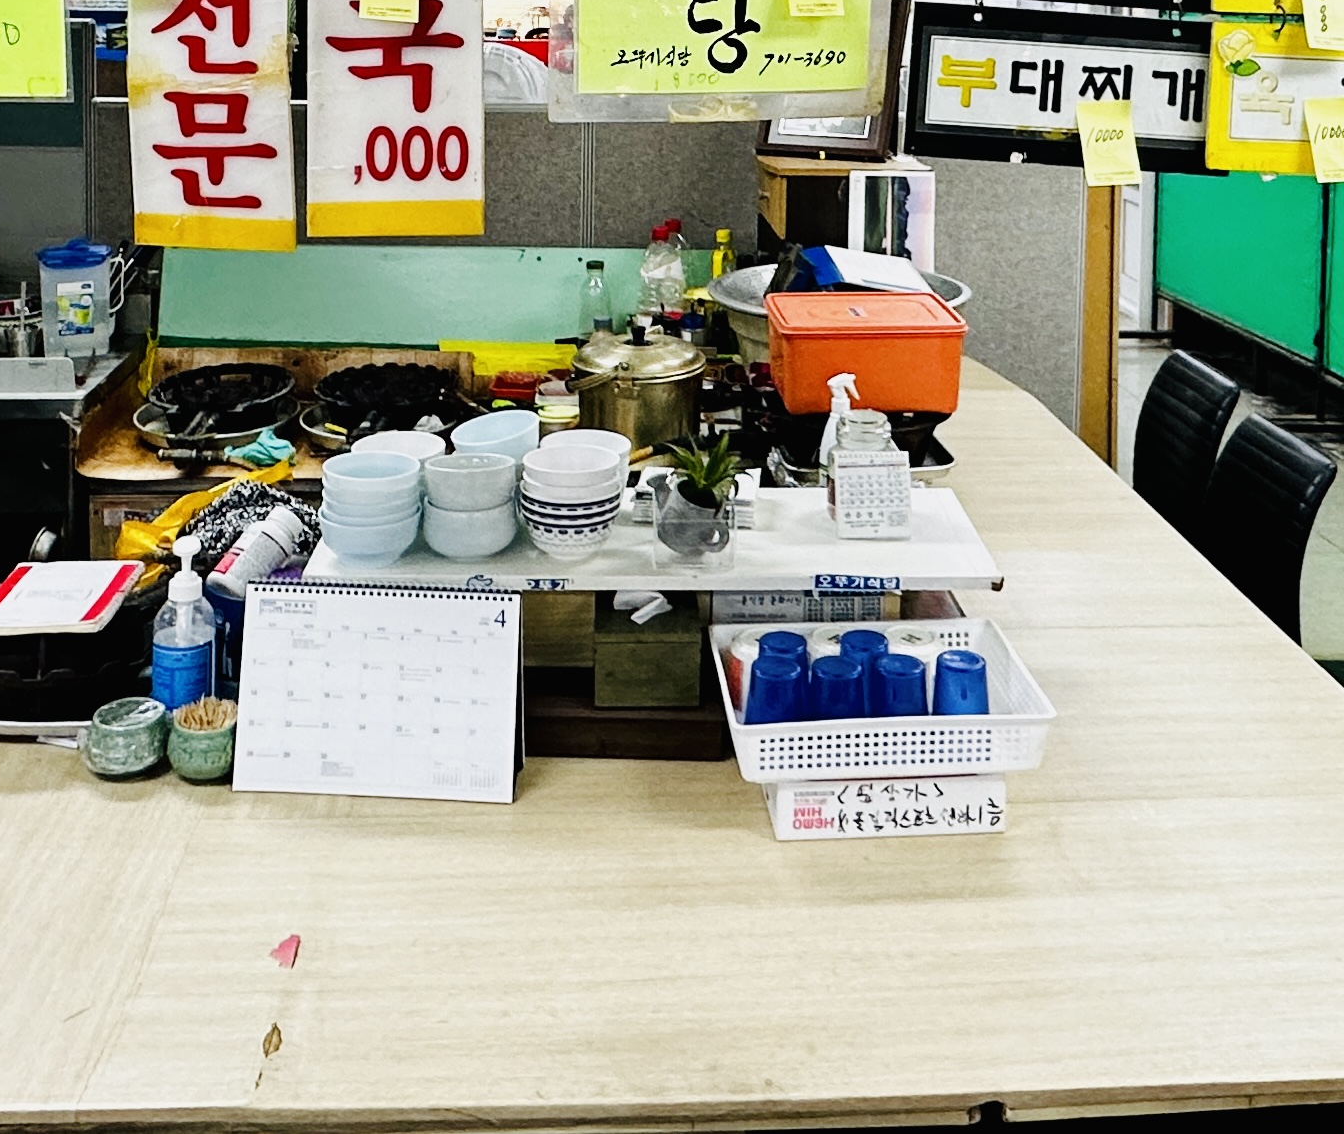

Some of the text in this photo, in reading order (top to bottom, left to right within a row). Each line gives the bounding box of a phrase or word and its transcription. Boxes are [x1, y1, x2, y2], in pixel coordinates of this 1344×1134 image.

[758, 48, 847, 76] 701-3690
[937, 54, 1206, 124] 부대찌개
[1086, 126, 1124, 149] 10000
[494, 609, 507, 628] 4
